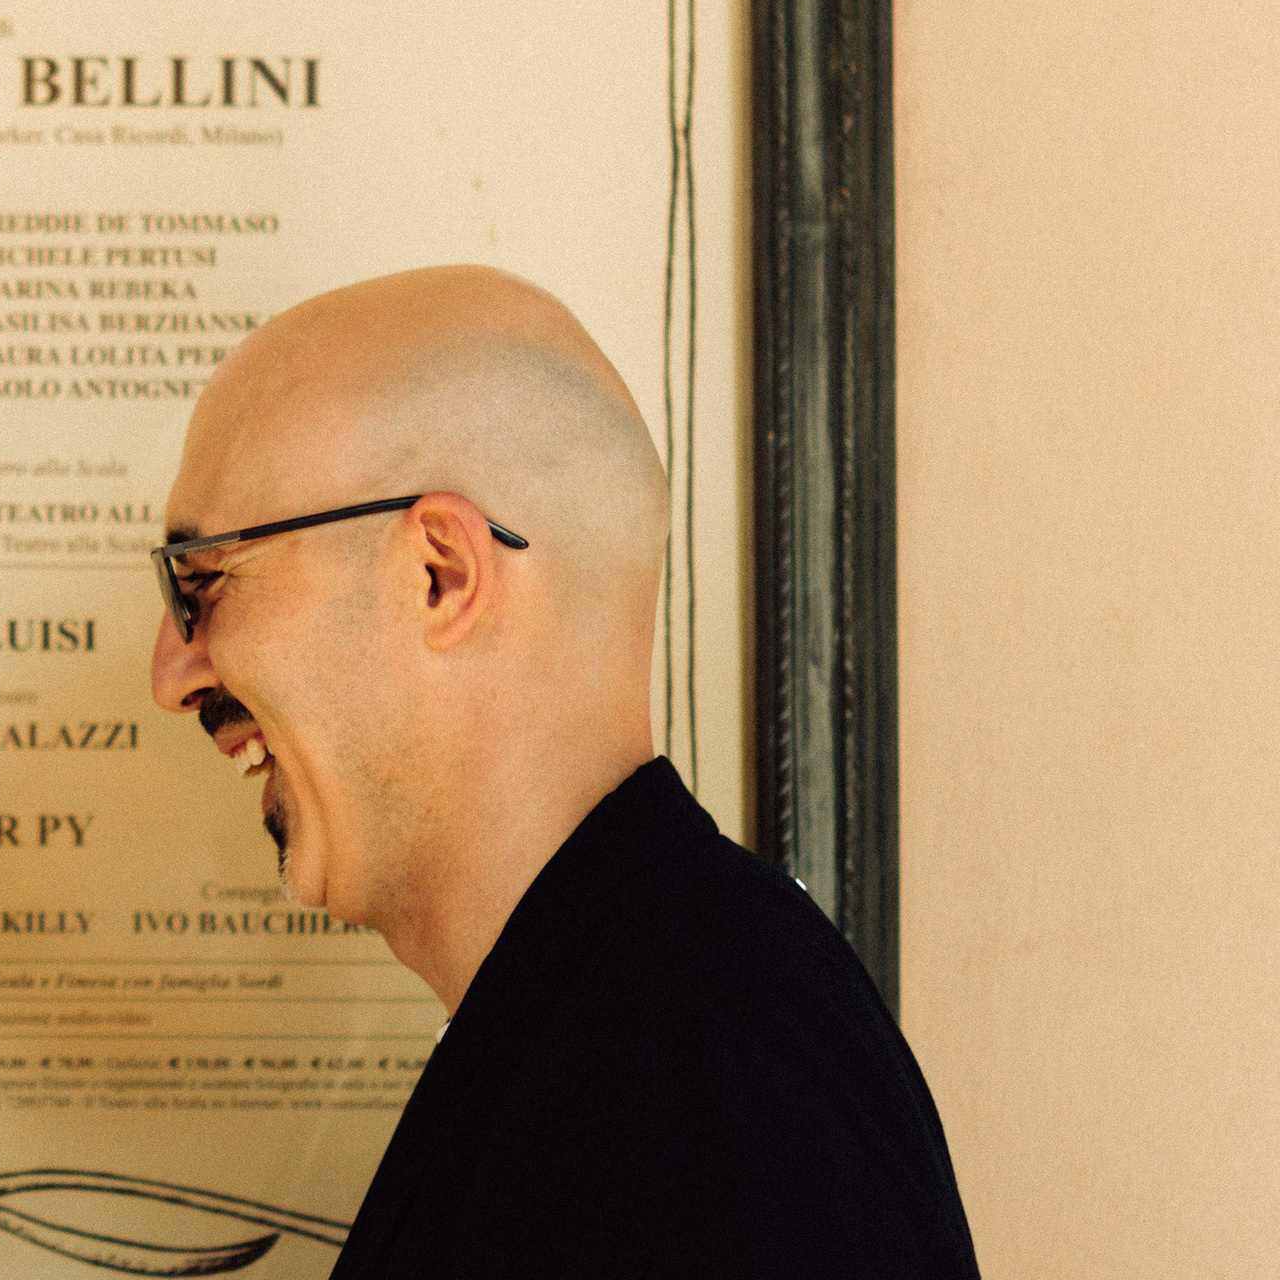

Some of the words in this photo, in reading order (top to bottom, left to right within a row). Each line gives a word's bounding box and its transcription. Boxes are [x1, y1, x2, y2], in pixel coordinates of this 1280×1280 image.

[22, 57, 319, 108] BELLINI
[96, 213, 130, 234] DE
[140, 213, 280, 235] TOMMASO
[105, 246, 217, 268] PERTUSI
[88, 280, 197, 300] REBEKA
[96, 310, 276, 336] BERZHANSK
[70, 345, 168, 366] LOLITA
[174, 346, 234, 367] PER
[75, 458, 130, 478] Scala
[1, 533, 64, 554] Teatro
[38, 814, 93, 847] PY
[0, 910, 93, 935] KILLY
[132, 911, 190, 934] IVO
